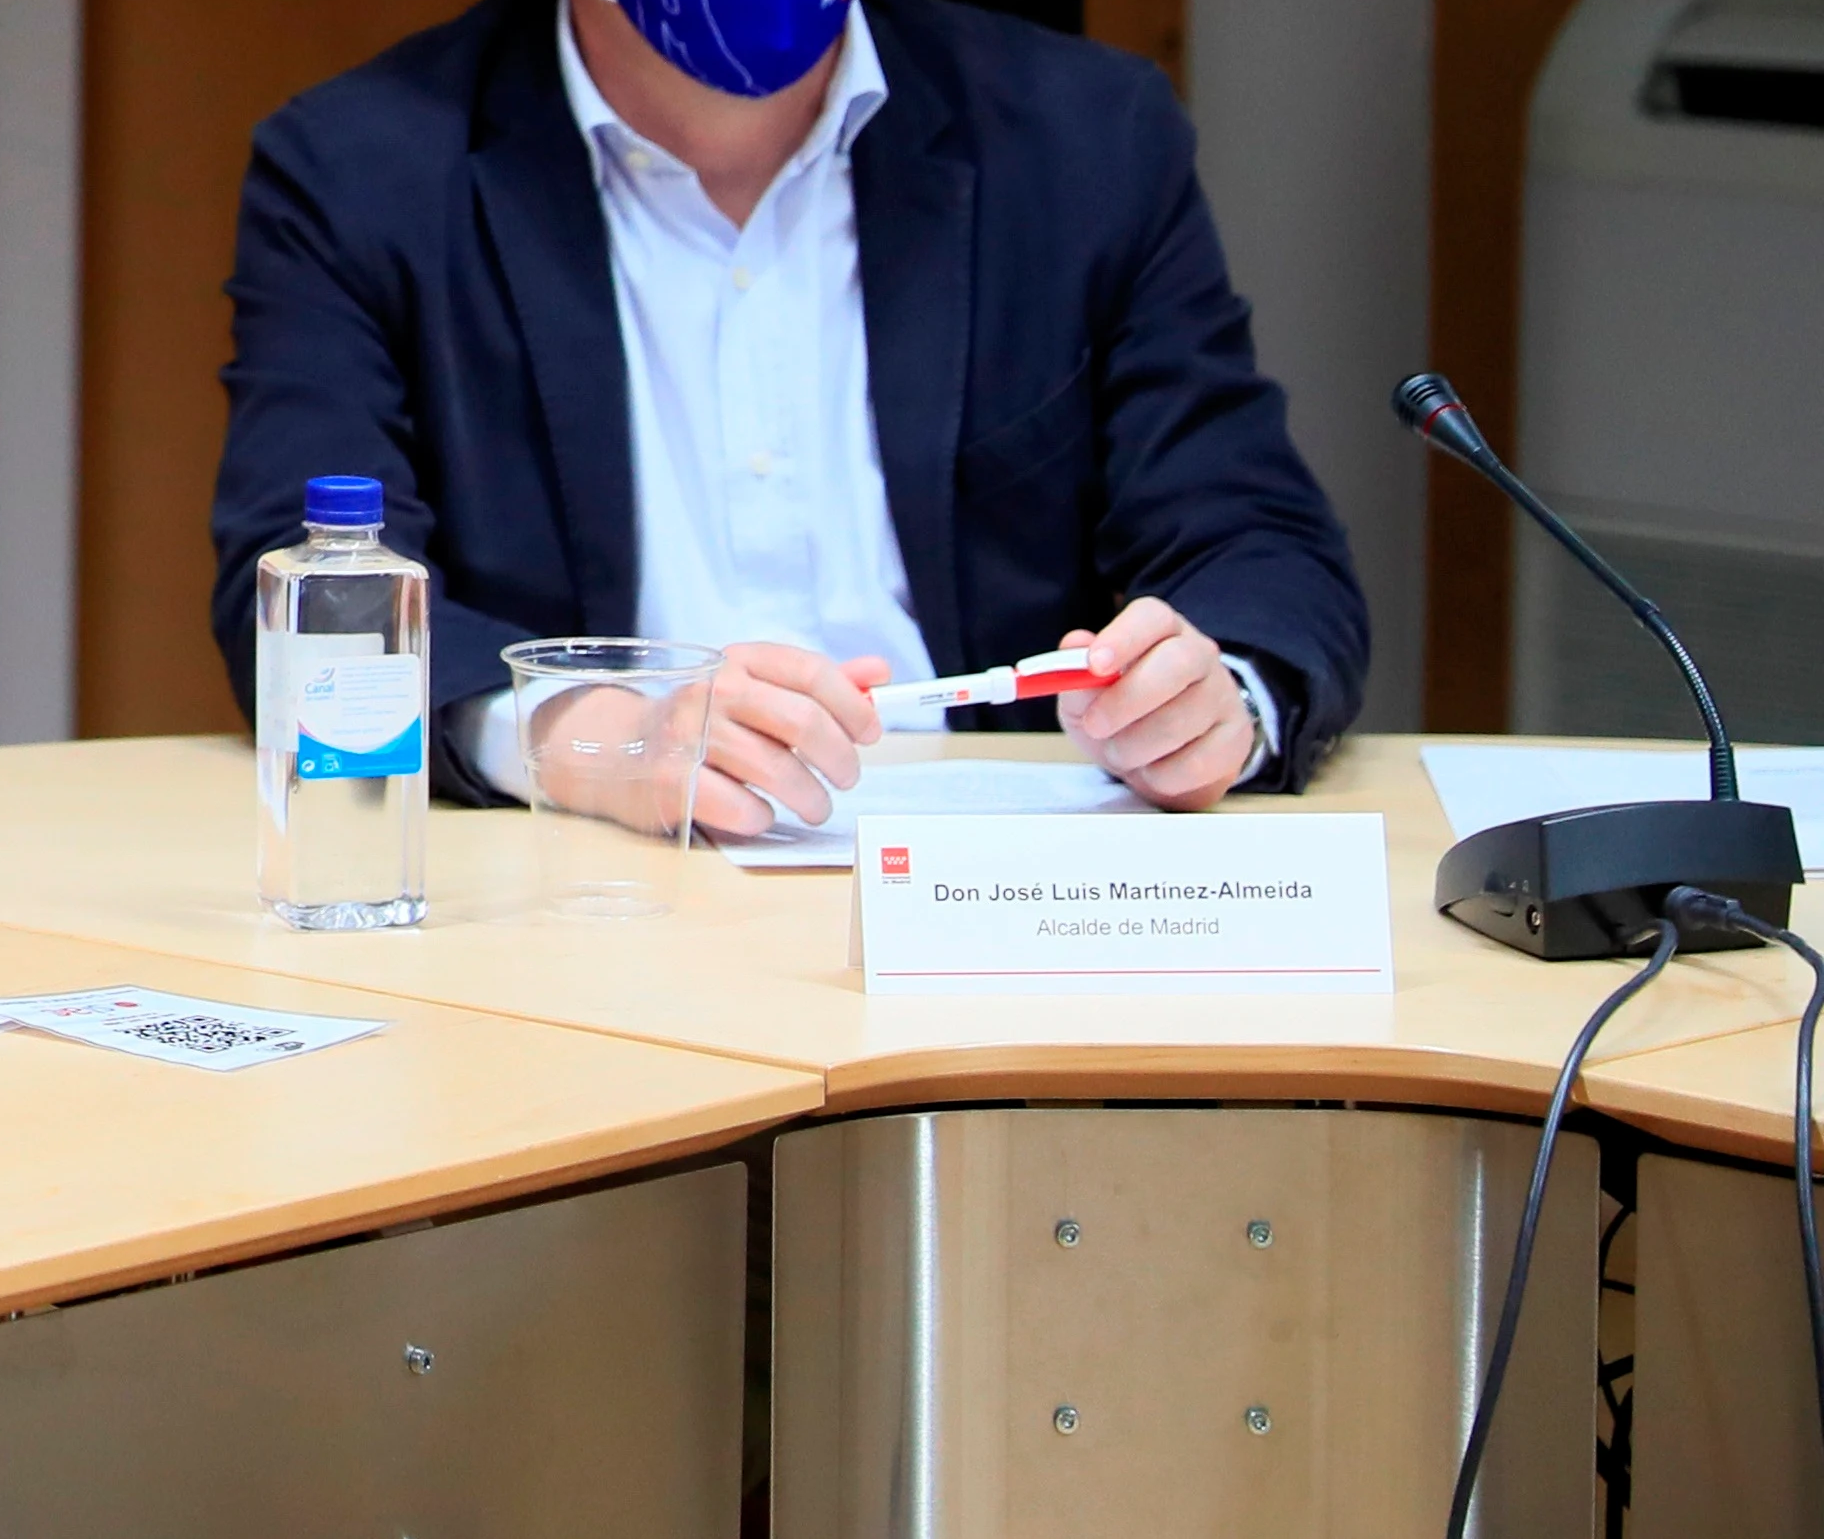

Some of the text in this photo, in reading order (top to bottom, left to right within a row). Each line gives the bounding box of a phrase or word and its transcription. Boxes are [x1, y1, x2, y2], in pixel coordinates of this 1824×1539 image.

[305, 682, 335, 695] Canal
[934, 880, 1313, 902] Don José Luis Martínez-Almeida
[1036, 917, 1220, 936] Alcalde de Madrid
